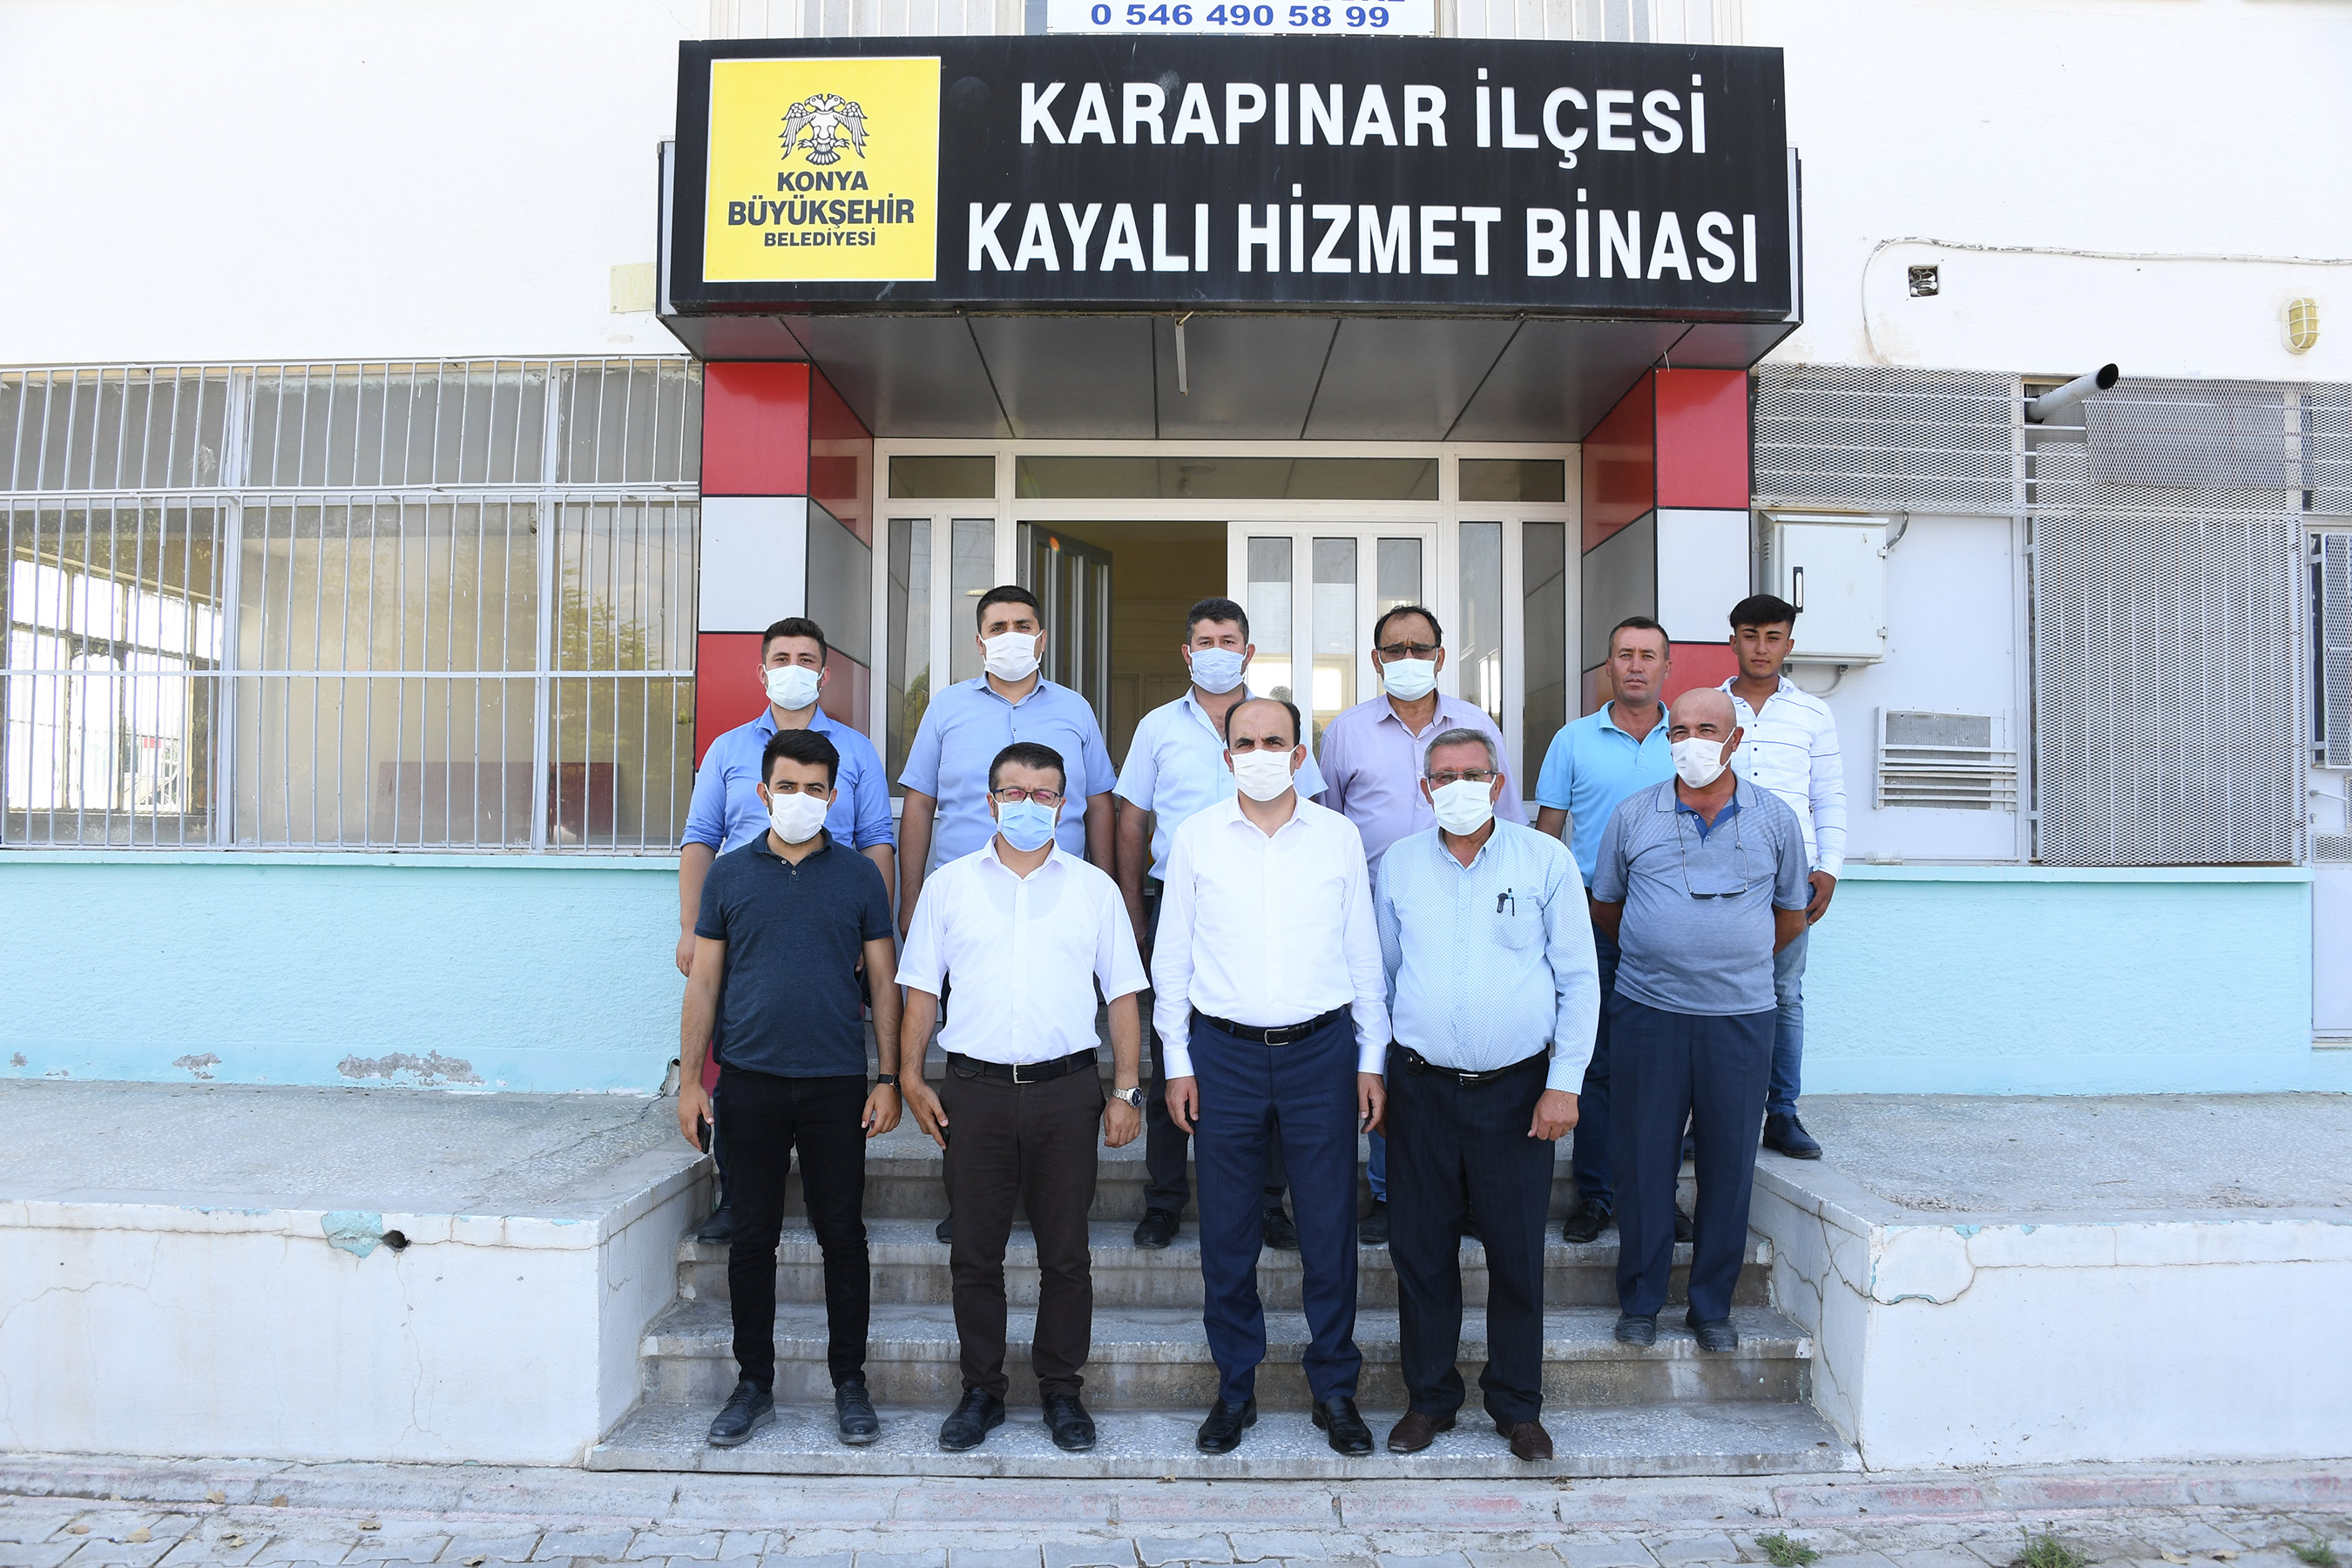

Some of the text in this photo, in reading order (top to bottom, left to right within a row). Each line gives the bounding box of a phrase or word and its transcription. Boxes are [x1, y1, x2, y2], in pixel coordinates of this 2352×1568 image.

[1091, 3, 1389, 28] 0 546 490 58 99
[1020, 67, 1707, 170] KARAPINAR İLÇESİ
[777, 171, 868, 192] KONYA
[727, 193, 915, 229] BÜYÜKŞEHİR
[764, 227, 876, 247] BELEDİYESİ
[968, 183, 1758, 284] KAYALI HİZMET BİNASI
